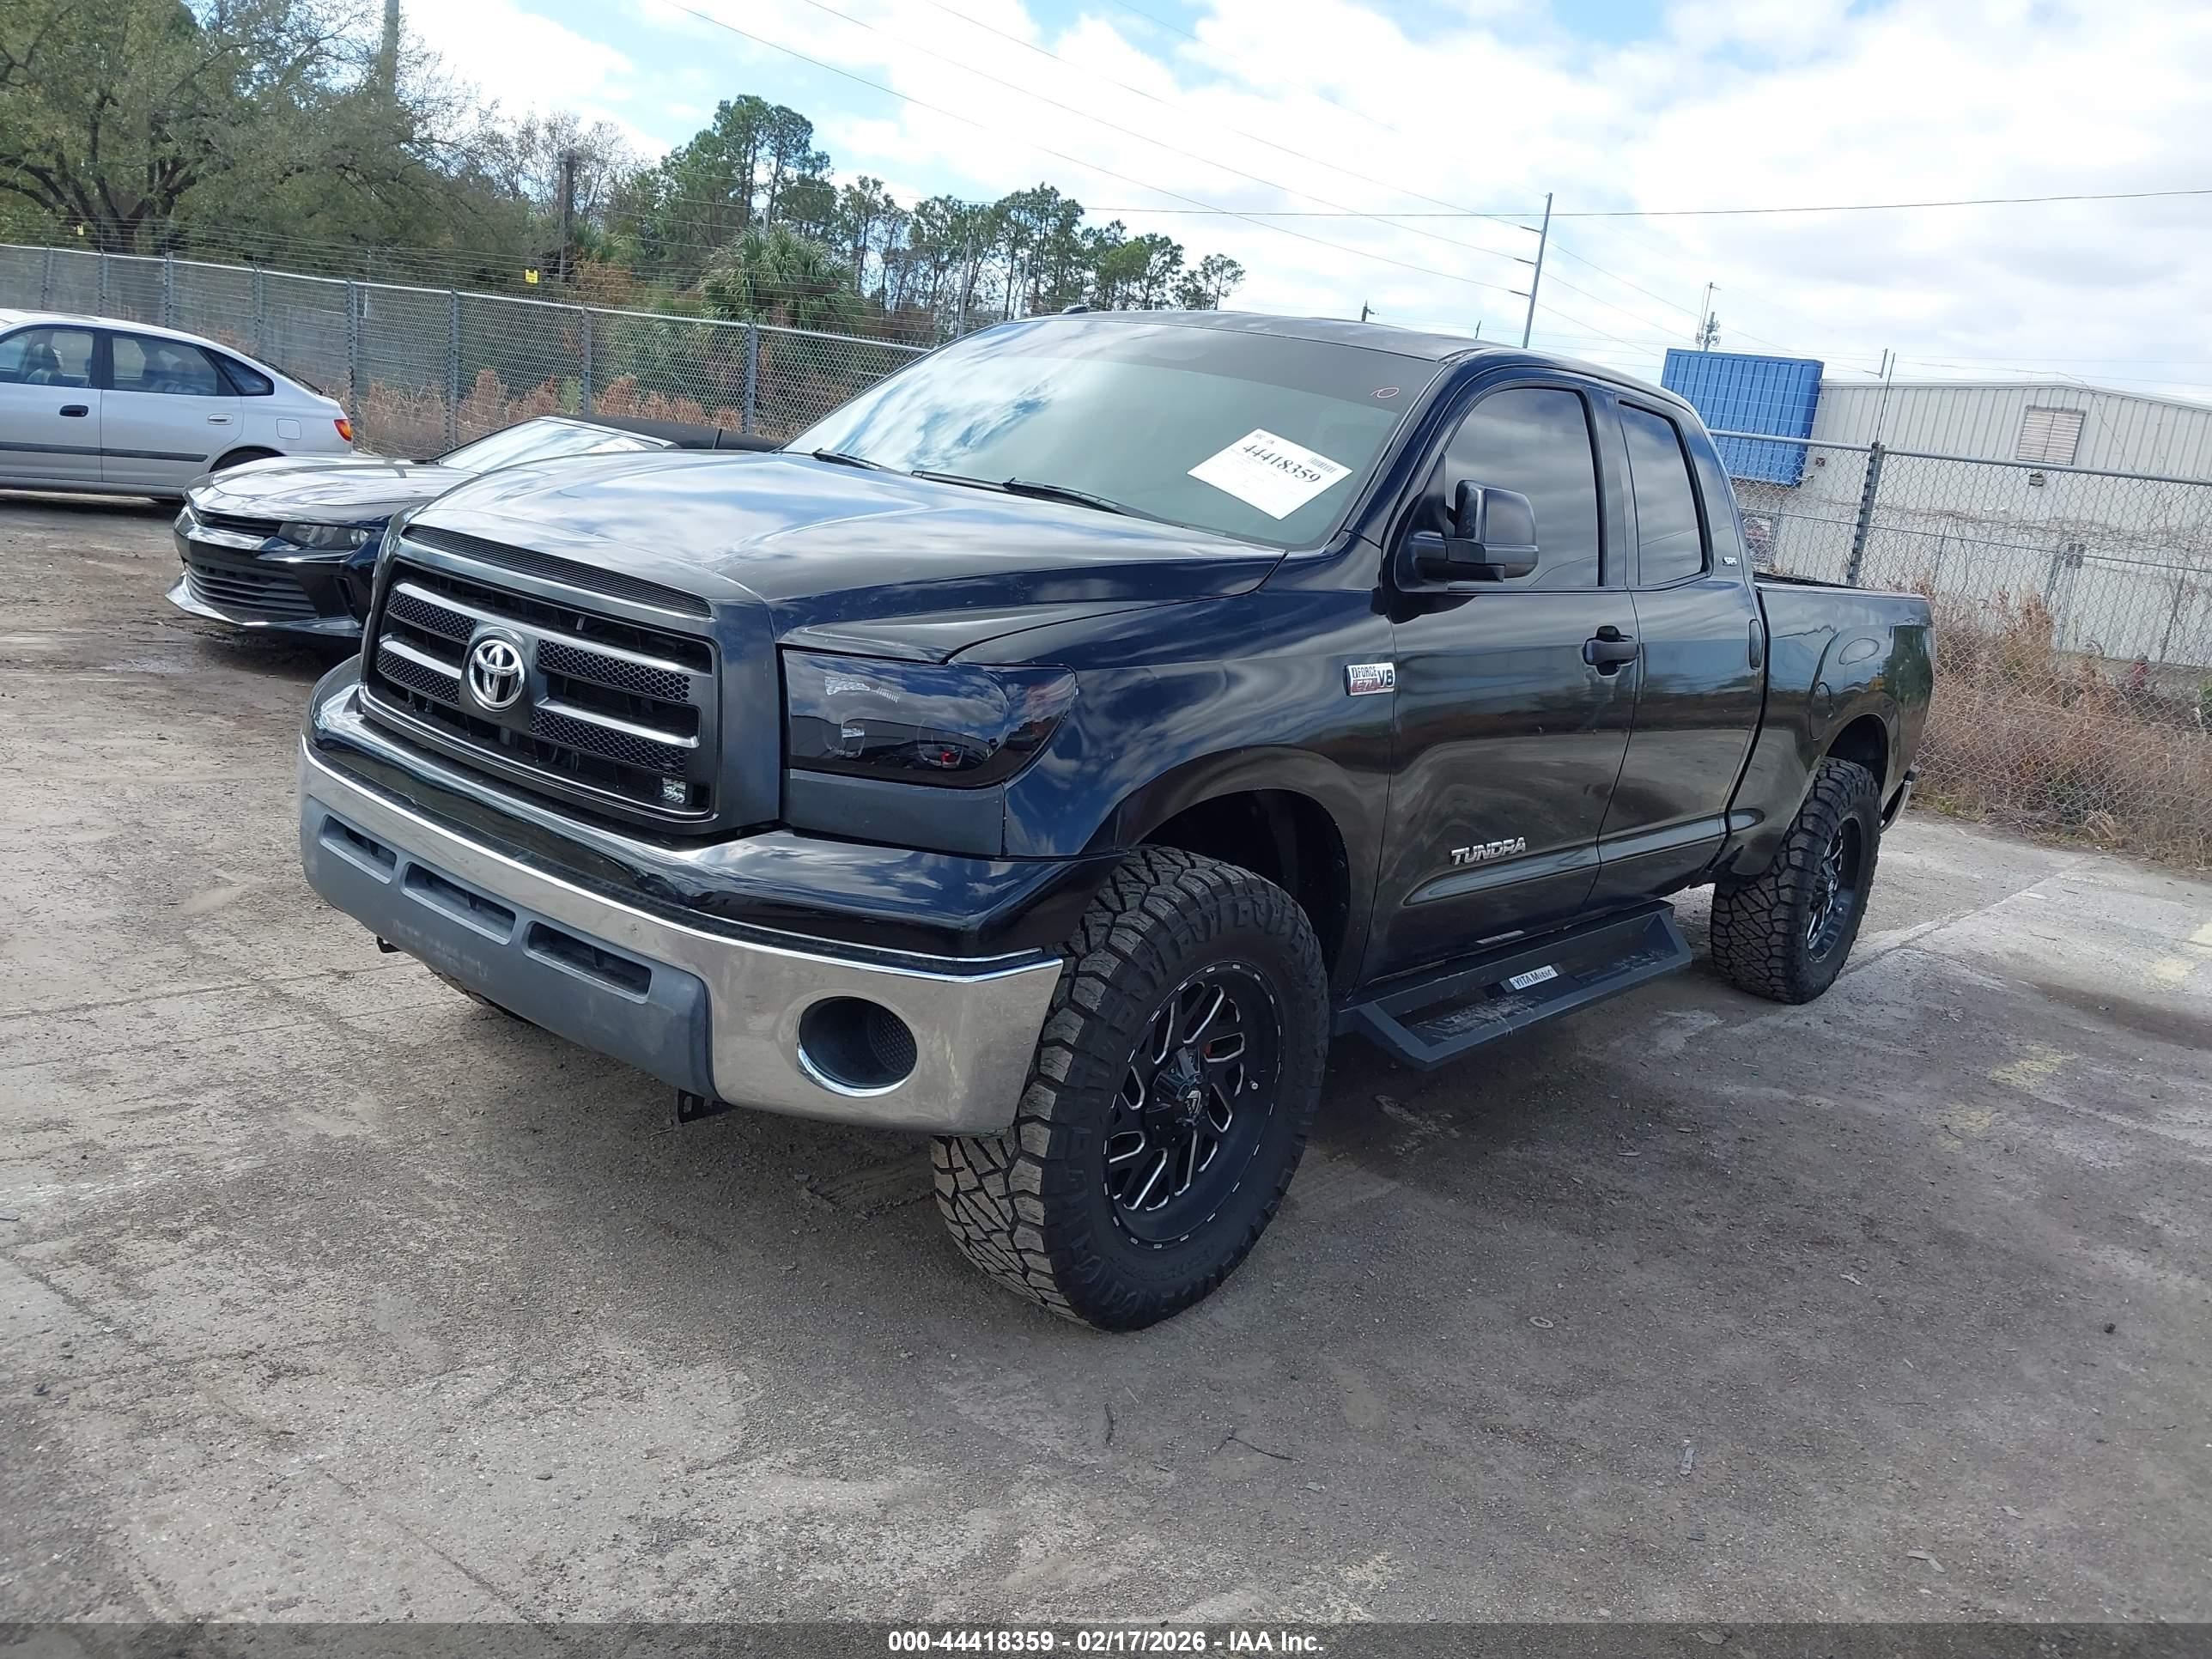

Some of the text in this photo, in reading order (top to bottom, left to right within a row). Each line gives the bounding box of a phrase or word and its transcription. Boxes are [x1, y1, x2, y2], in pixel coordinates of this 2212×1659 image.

[1243, 444, 1322, 483] 44418359
[1377, 669, 1394, 687] V8
[1450, 836, 1527, 866] TUNDRA
